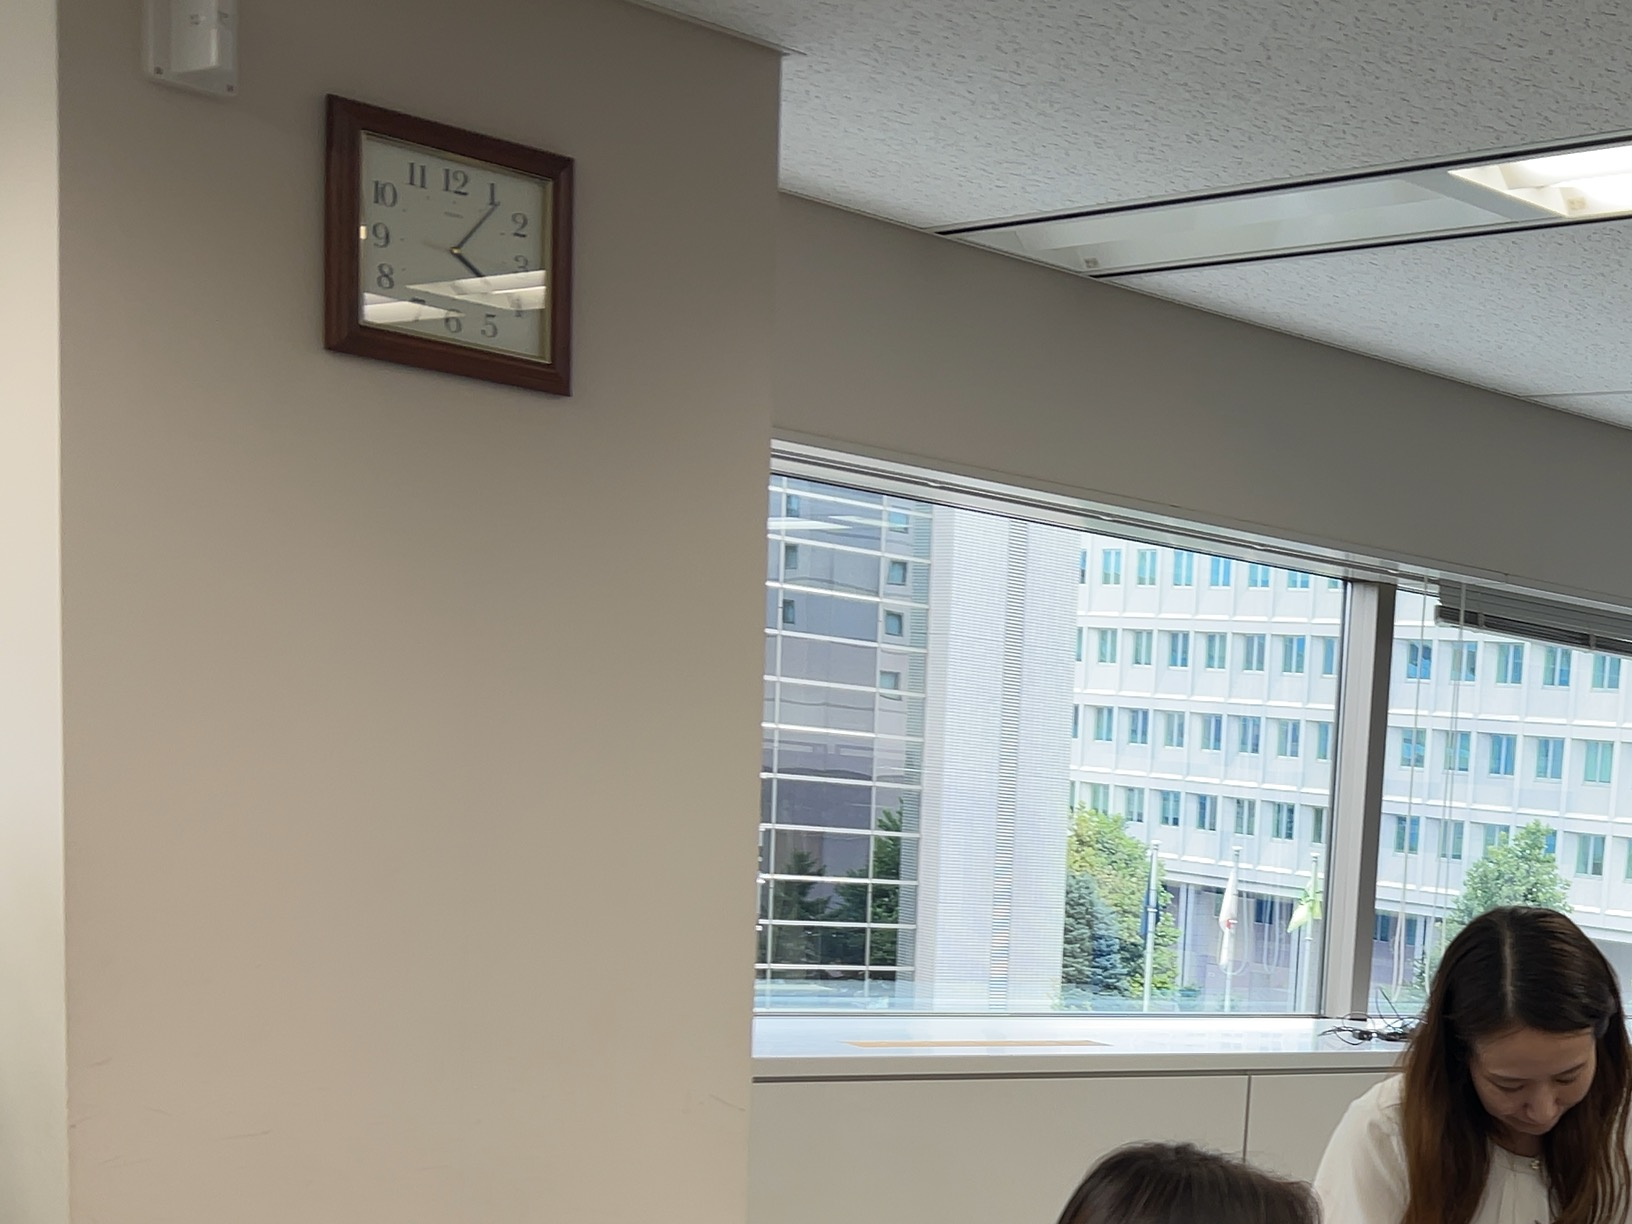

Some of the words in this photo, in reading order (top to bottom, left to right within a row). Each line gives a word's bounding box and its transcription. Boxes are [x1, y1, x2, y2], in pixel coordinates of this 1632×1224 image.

[405, 162, 427, 189] 11
[442, 168, 469, 196] 12
[372, 180, 398, 207] 10
[487, 182, 498, 206] 1
[372, 222, 390, 248] 9
[511, 212, 528, 238] 2
[376, 262, 395, 289] 8
[444, 308, 462, 334] 6
[480, 313, 498, 338] 5
